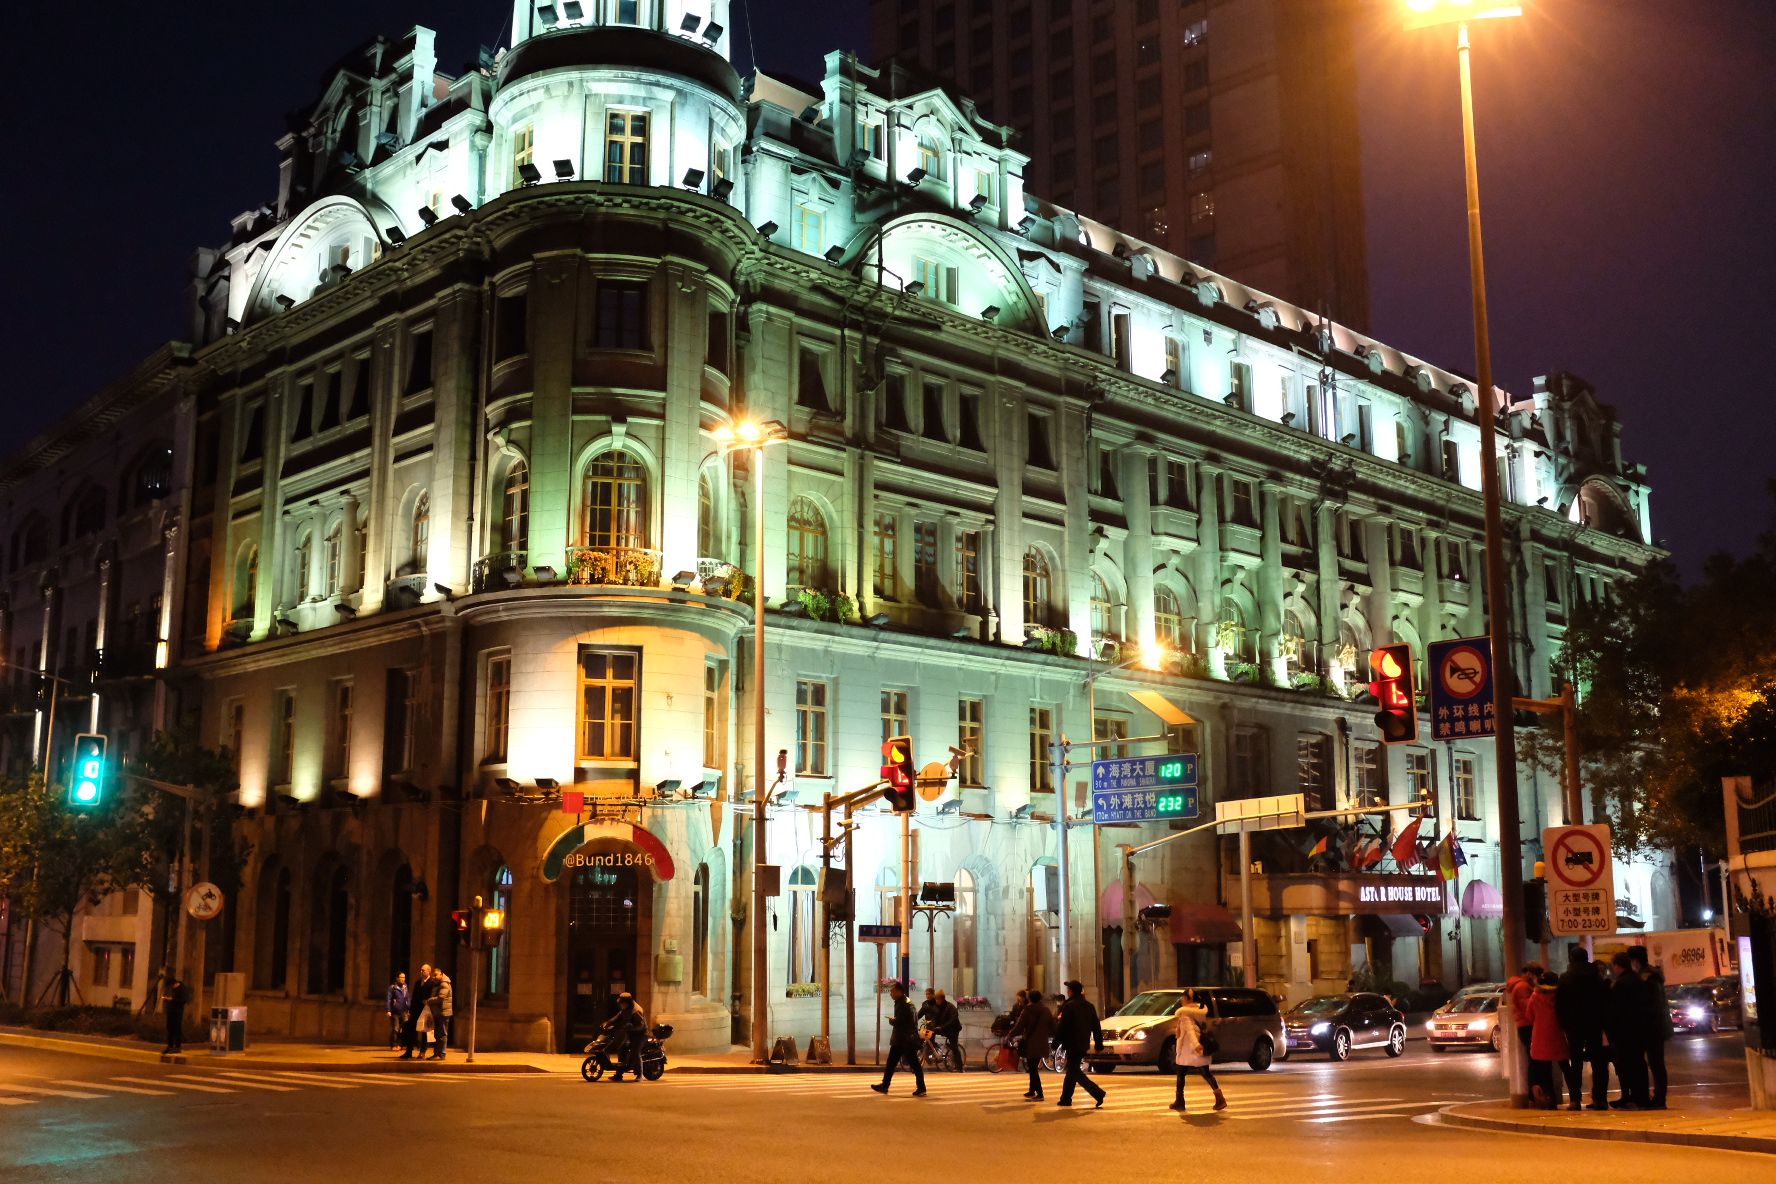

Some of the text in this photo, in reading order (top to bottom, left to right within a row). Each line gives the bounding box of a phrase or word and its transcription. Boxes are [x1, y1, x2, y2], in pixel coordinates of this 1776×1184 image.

[1439, 702, 1494, 719] 外环线内
[1109, 760, 1193, 778] 海湾大厦 120 P
[1110, 792, 1194, 812] 外滩茂悦 232 P
[564, 853, 652, 868] @Bund1846
[1387, 886, 1413, 901] HOUSE
[1414, 886, 1441, 901] HOTEL
[1562, 892, 1600, 903] 大型号牌
[1563, 906, 1600, 917] 小型号牌
